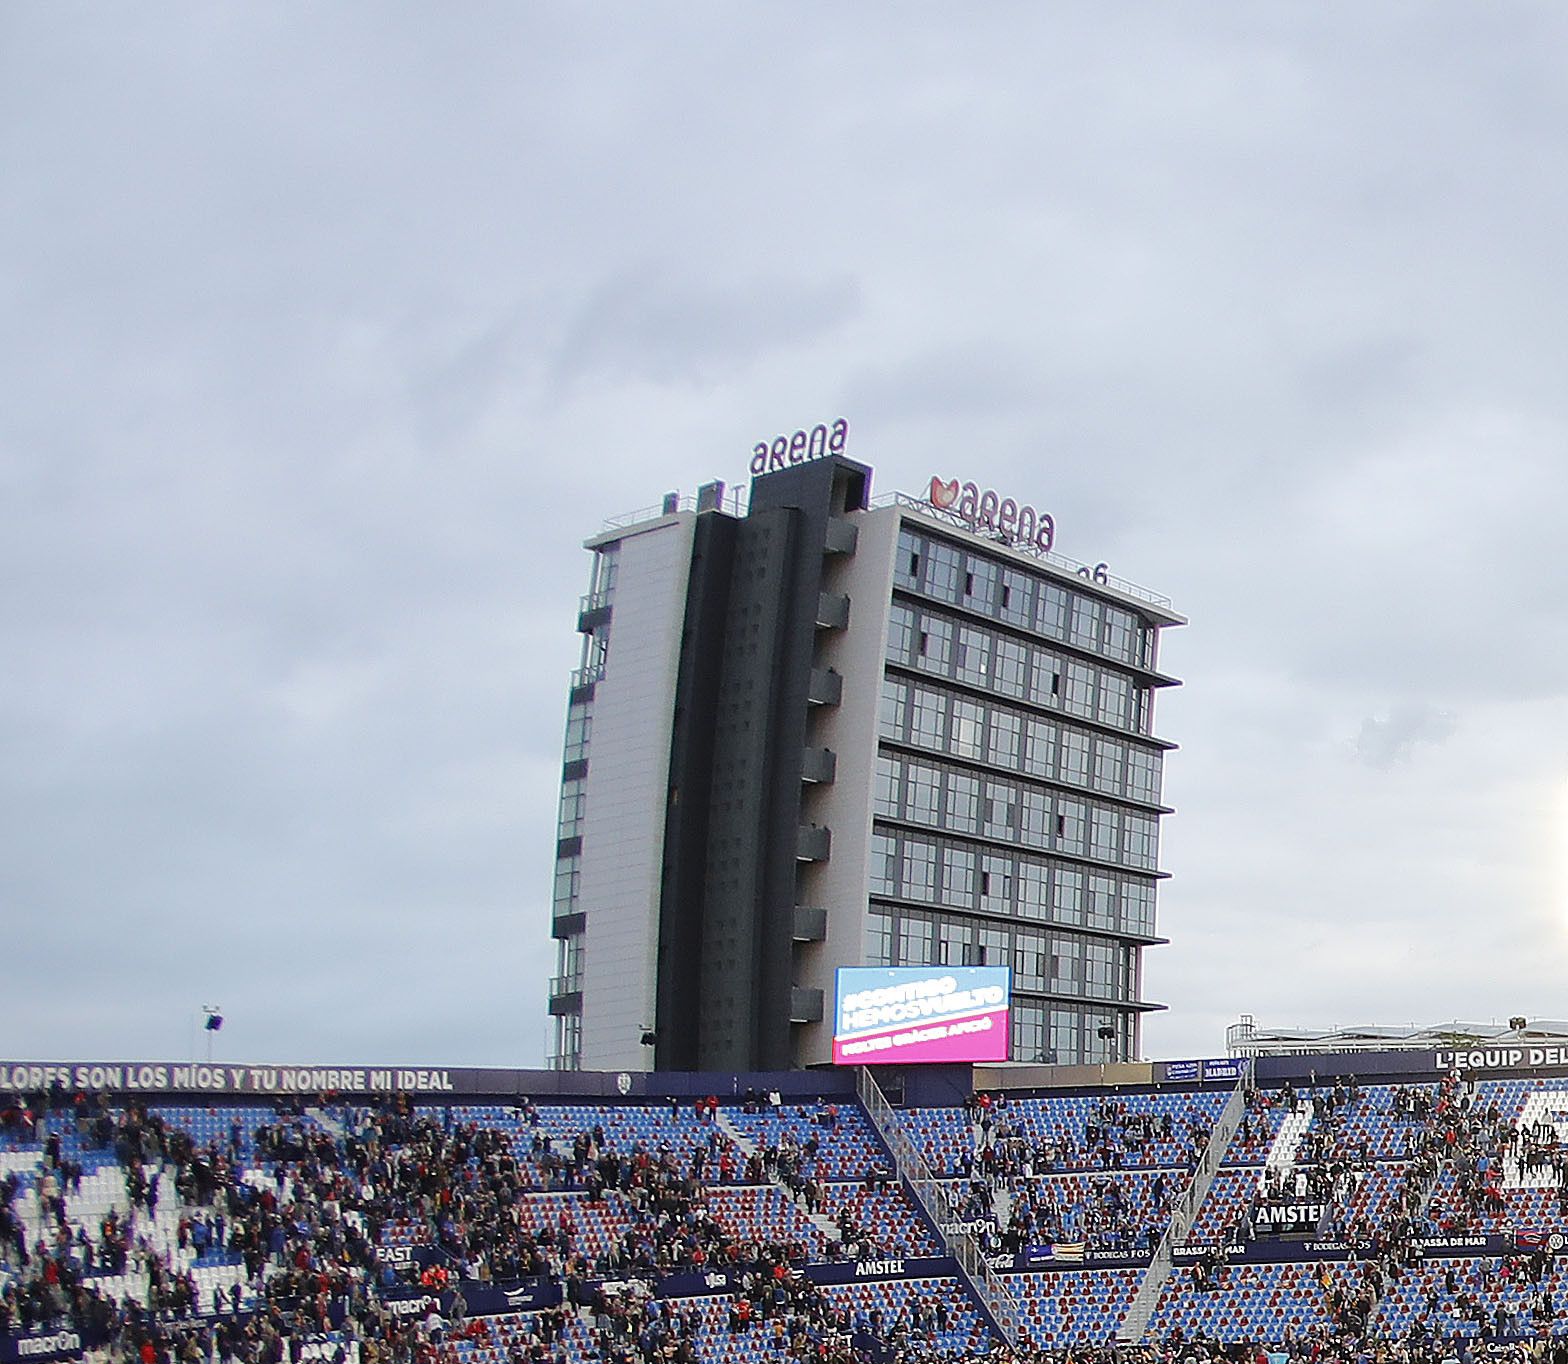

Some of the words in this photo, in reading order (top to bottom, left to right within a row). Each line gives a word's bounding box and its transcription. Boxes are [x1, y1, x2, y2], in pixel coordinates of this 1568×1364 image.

[960, 480, 1057, 552] arena
[1436, 1050, 1522, 1069] L'EQUIP
[75, 1066, 121, 1089] SON
[126, 1066, 167, 1089] LOS
[172, 1063, 226, 1089] MÍOS
[231, 1068, 246, 1089] Y
[250, 1069, 276, 1089] TU
[281, 1070, 366, 1090] NOMBRE
[370, 1070, 392, 1090] MI
[396, 1070, 453, 1090] IDEAL
[855, 1260, 905, 1277] AMSTEL
